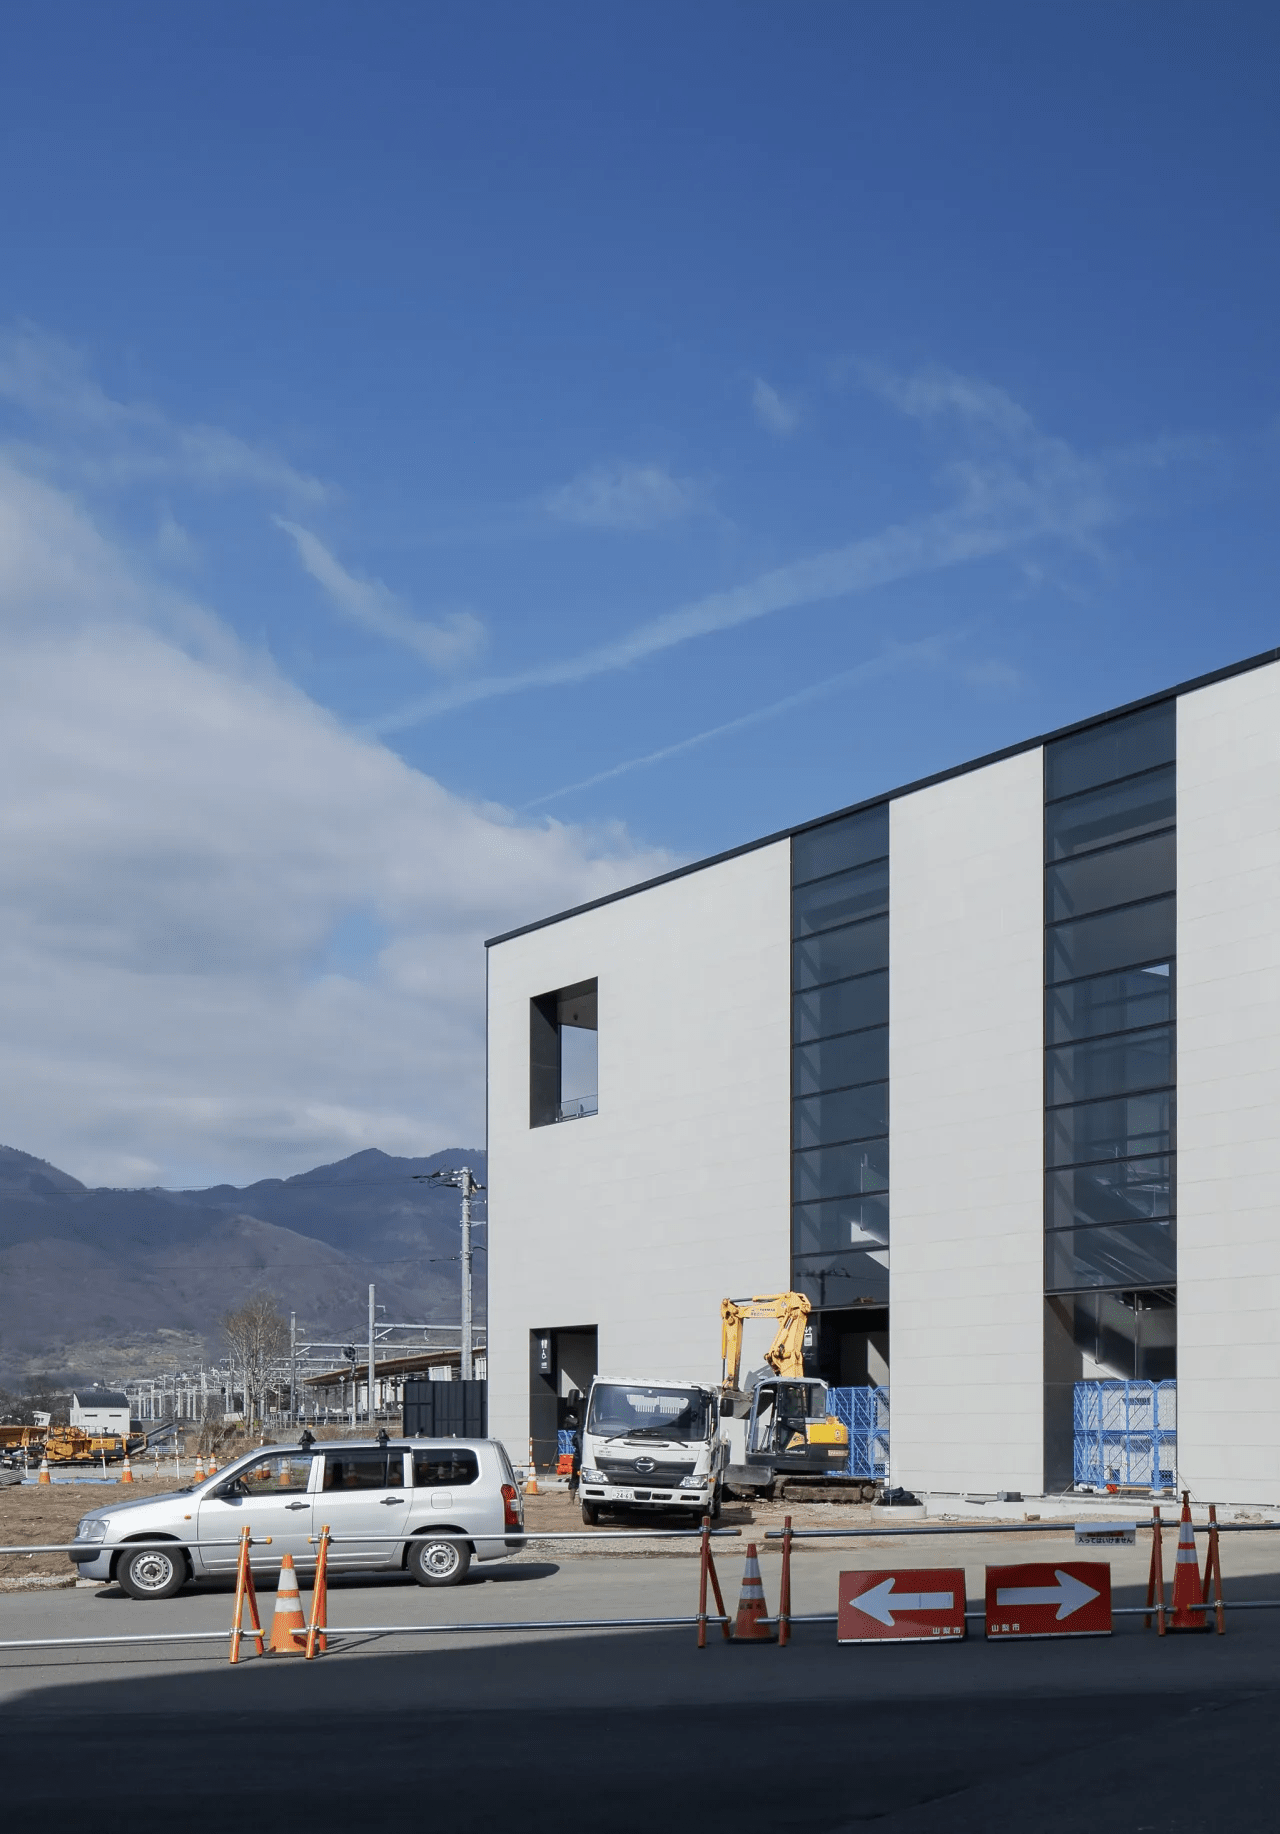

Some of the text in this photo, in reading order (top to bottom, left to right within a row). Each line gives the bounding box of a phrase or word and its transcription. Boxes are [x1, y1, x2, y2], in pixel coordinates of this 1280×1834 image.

[932, 1627, 961, 1635] 山梨市
[992, 1623, 1020, 1632] 山梨市
